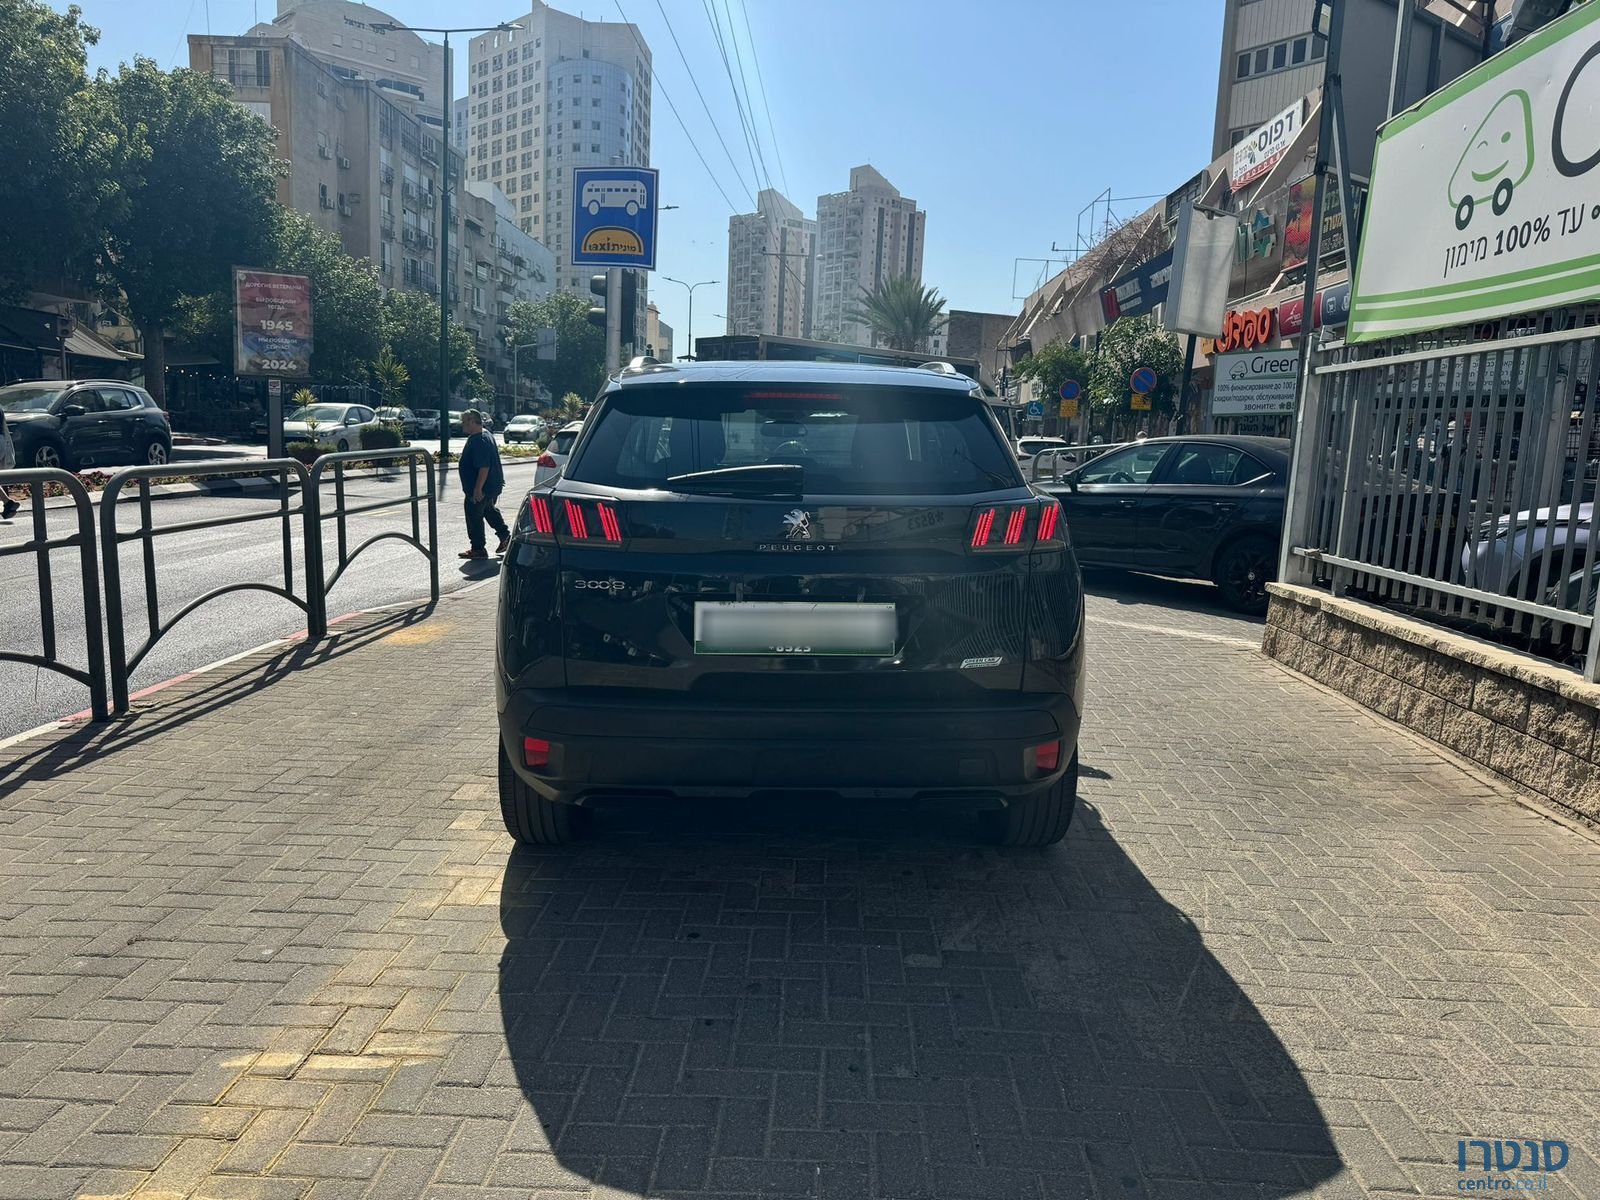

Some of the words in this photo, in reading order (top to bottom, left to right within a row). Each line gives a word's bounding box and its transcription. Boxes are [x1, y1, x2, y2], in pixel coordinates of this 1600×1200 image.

[1257, 109, 1295, 152] דפוס
[1557, 203, 1585, 236] עד
[1494, 214, 1551, 256] 100%
[589, 236, 610, 251] taxi
[611, 242, 637, 252] מונית
[1443, 236, 1488, 278] מימון
[260, 320, 294, 331] 1945
[262, 360, 297, 370] 2024
[1217, 384, 1230, 392] 100%
[1231, 383, 1273, 392] финансирование
[1283, 382, 1292, 390] 100
[1243, 403, 1276, 411] звоните:
[575, 579, 625, 590] 3008
